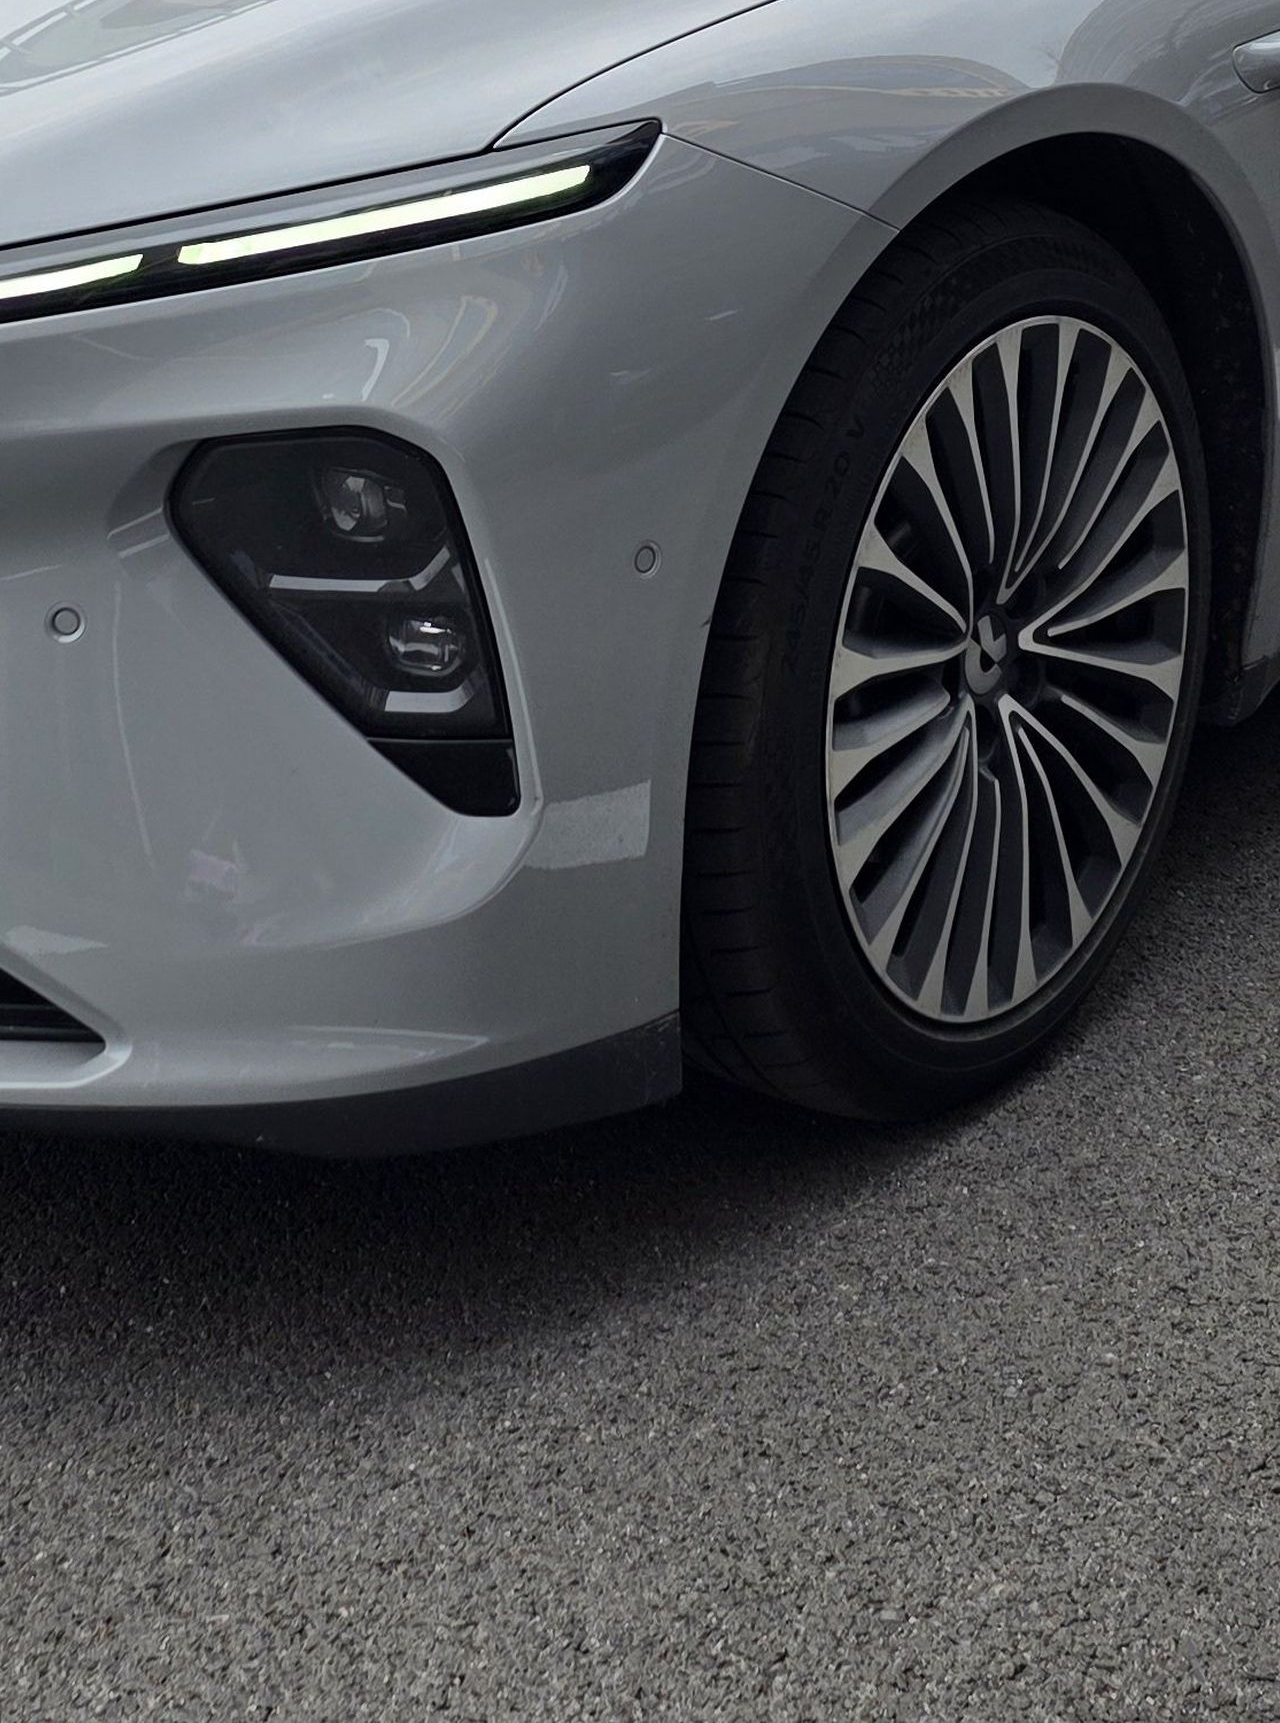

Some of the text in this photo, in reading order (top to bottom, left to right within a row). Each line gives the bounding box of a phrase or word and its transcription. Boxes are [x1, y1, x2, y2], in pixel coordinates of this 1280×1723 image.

[812, 507, 833, 532] R
[824, 450, 850, 497] 20
[845, 414, 865, 439] V
